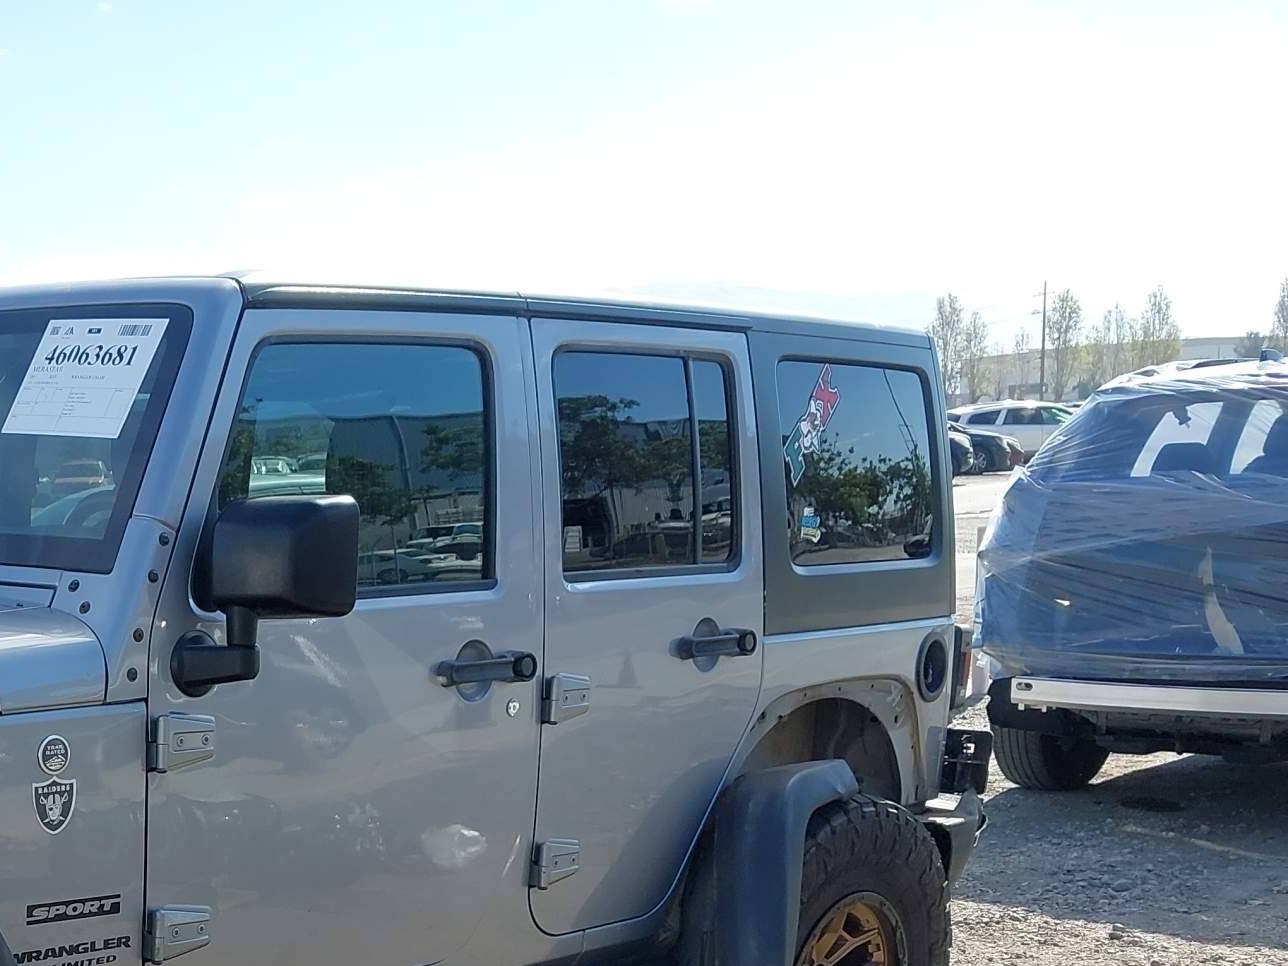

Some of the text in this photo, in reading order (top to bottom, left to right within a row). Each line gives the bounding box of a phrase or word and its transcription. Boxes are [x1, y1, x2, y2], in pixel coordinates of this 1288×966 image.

[45, 344, 138, 366] 46063681
[38, 784, 71, 794] RAIDERS
[31, 898, 120, 922] SPORT
